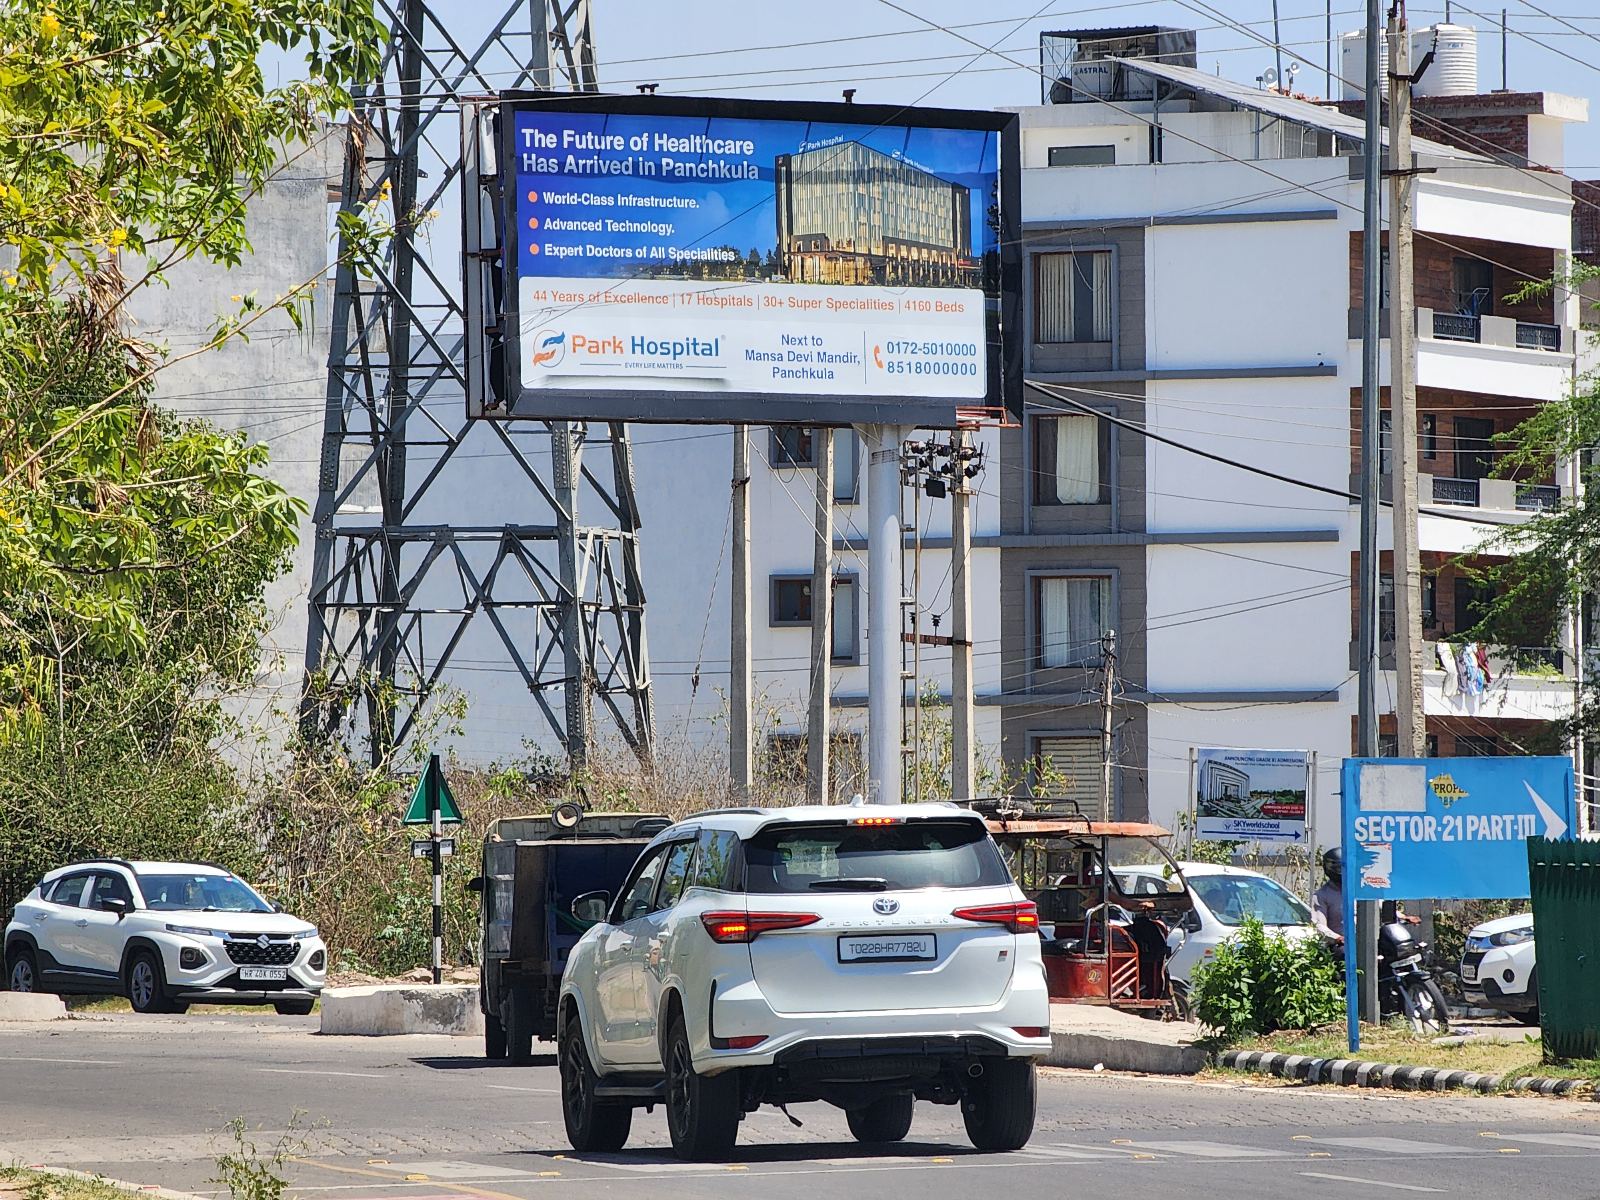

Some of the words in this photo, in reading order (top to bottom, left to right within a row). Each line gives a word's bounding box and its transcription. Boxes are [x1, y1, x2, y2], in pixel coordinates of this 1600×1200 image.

[1080, 66, 1108, 74] ASTRAL
[521, 129, 558, 148] The
[563, 130, 625, 150] Future
[629, 132, 649, 151] of
[654, 134, 754, 155] Healthcare
[807, 141, 821, 150] Park
[821, 134, 844, 147] Hospital
[522, 153, 559, 173] Has
[563, 154, 633, 175] Arrived
[638, 158, 656, 176] in
[661, 158, 759, 179] Panchkula
[542, 191, 614, 206] World-Class
[617, 194, 700, 209] Infrastructure.
[544, 218, 602, 232] Advanced
[605, 219, 675, 235] Technology.
[544, 243, 583, 259] Expert
[586, 245, 632, 259] Doctors
[635, 246, 648, 259] of
[649, 246, 665, 260] All
[533, 290, 547, 301] 44
[551, 290, 584, 303] Years
[588, 291, 600, 303] of
[604, 291, 669, 305] Excellence
[679, 293, 692, 305] 17
[697, 293, 752, 308] Hospitals
[763, 296, 785, 308] 30+
[788, 297, 821, 310] Super
[826, 297, 894, 312] Specialities
[904, 301, 931, 312] 4160
[935, 302, 965, 313] Beds
[571, 335, 624, 355] Park
[631, 336, 719, 360] Hospital
[781, 334, 808, 346] Next
[811, 335, 823, 346] to
[887, 341, 977, 356] 0172-5010000
[656, 362, 683, 370] MATTERS
[745, 349, 783, 362] Mansa
[787, 351, 813, 363] Devi
[817, 351, 861, 366] Mandir,
[772, 366, 834, 380] Panchkula
[887, 361, 977, 376] 8518000000
